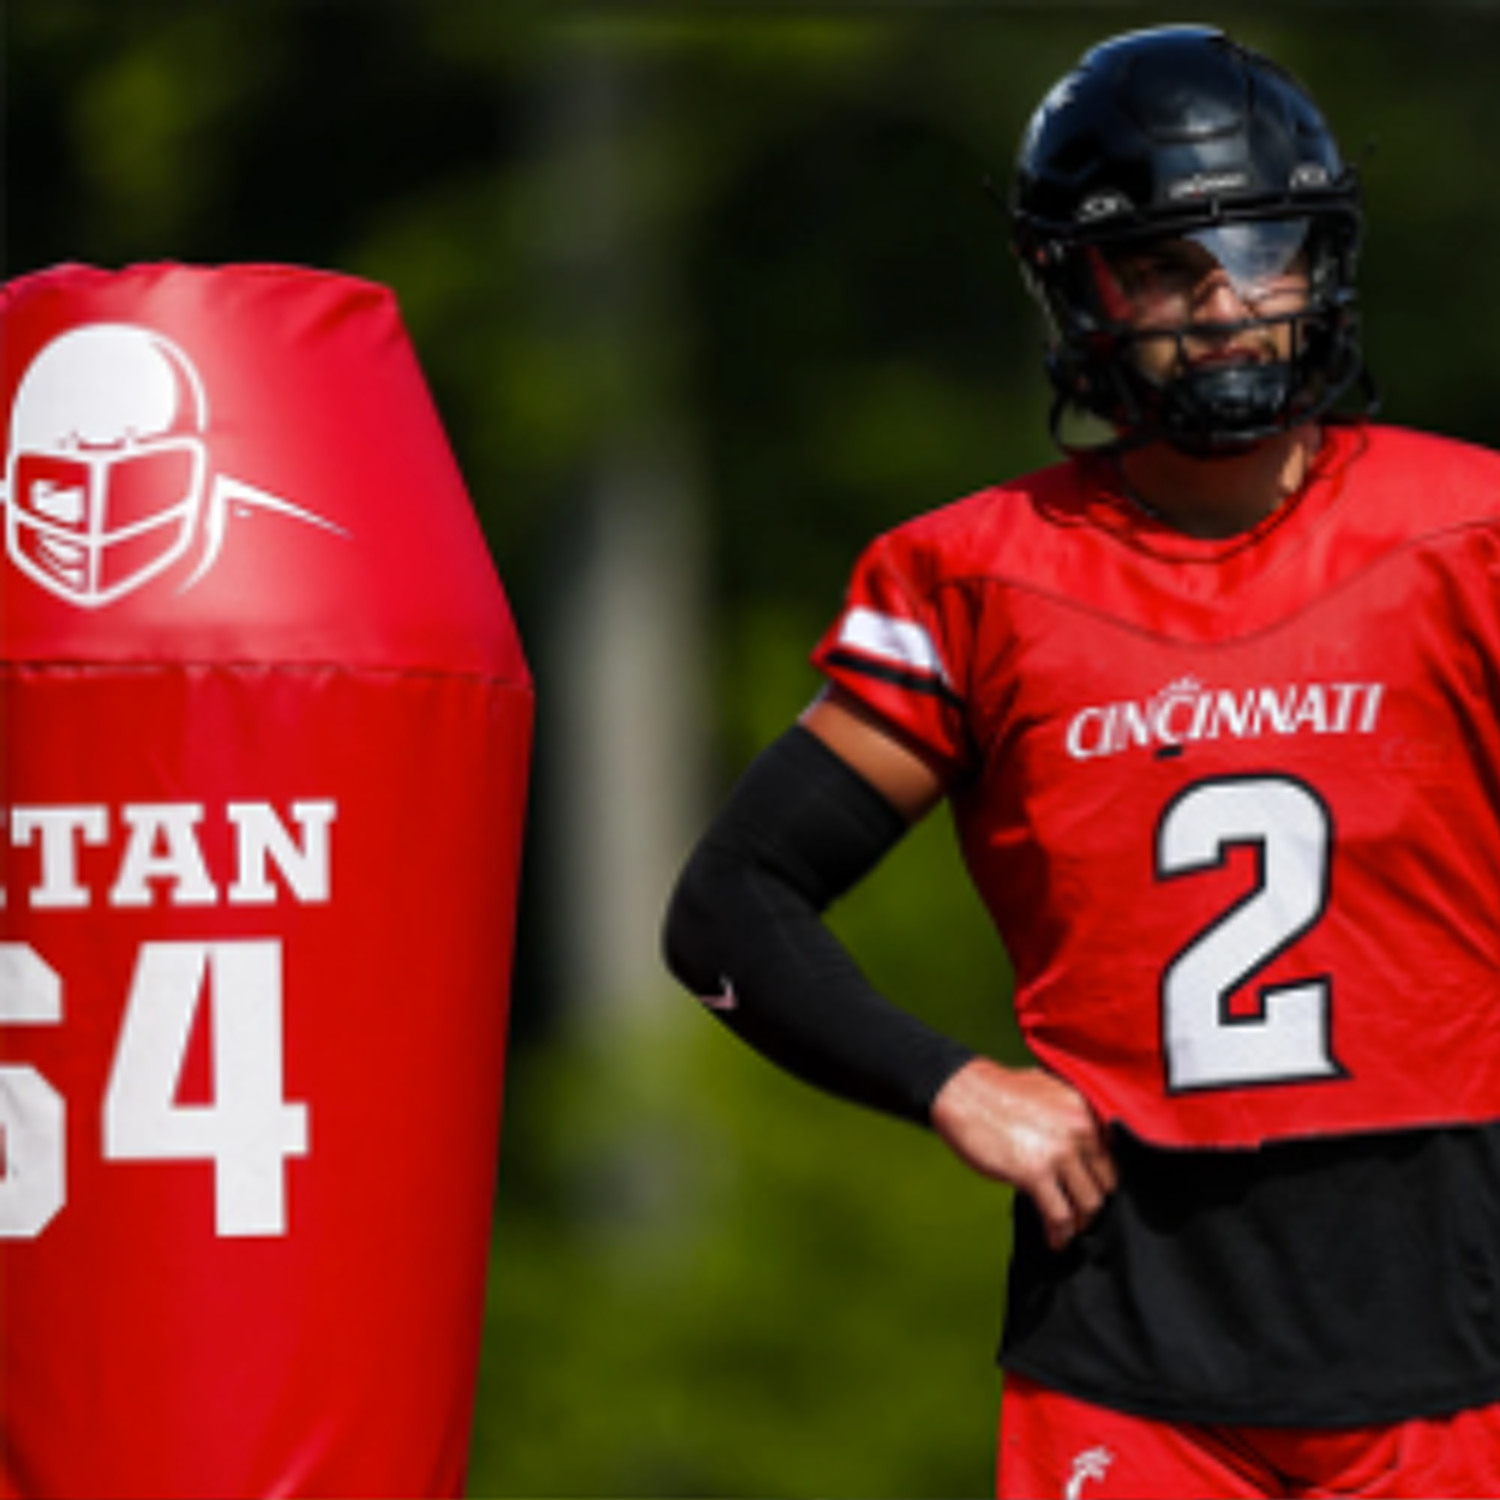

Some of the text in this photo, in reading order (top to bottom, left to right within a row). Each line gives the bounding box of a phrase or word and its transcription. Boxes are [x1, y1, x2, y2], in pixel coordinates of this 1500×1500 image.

[1065, 674, 1384, 761] CINCINNATI
[0, 799, 337, 908] TAN
[1154, 771, 1350, 1096] 2
